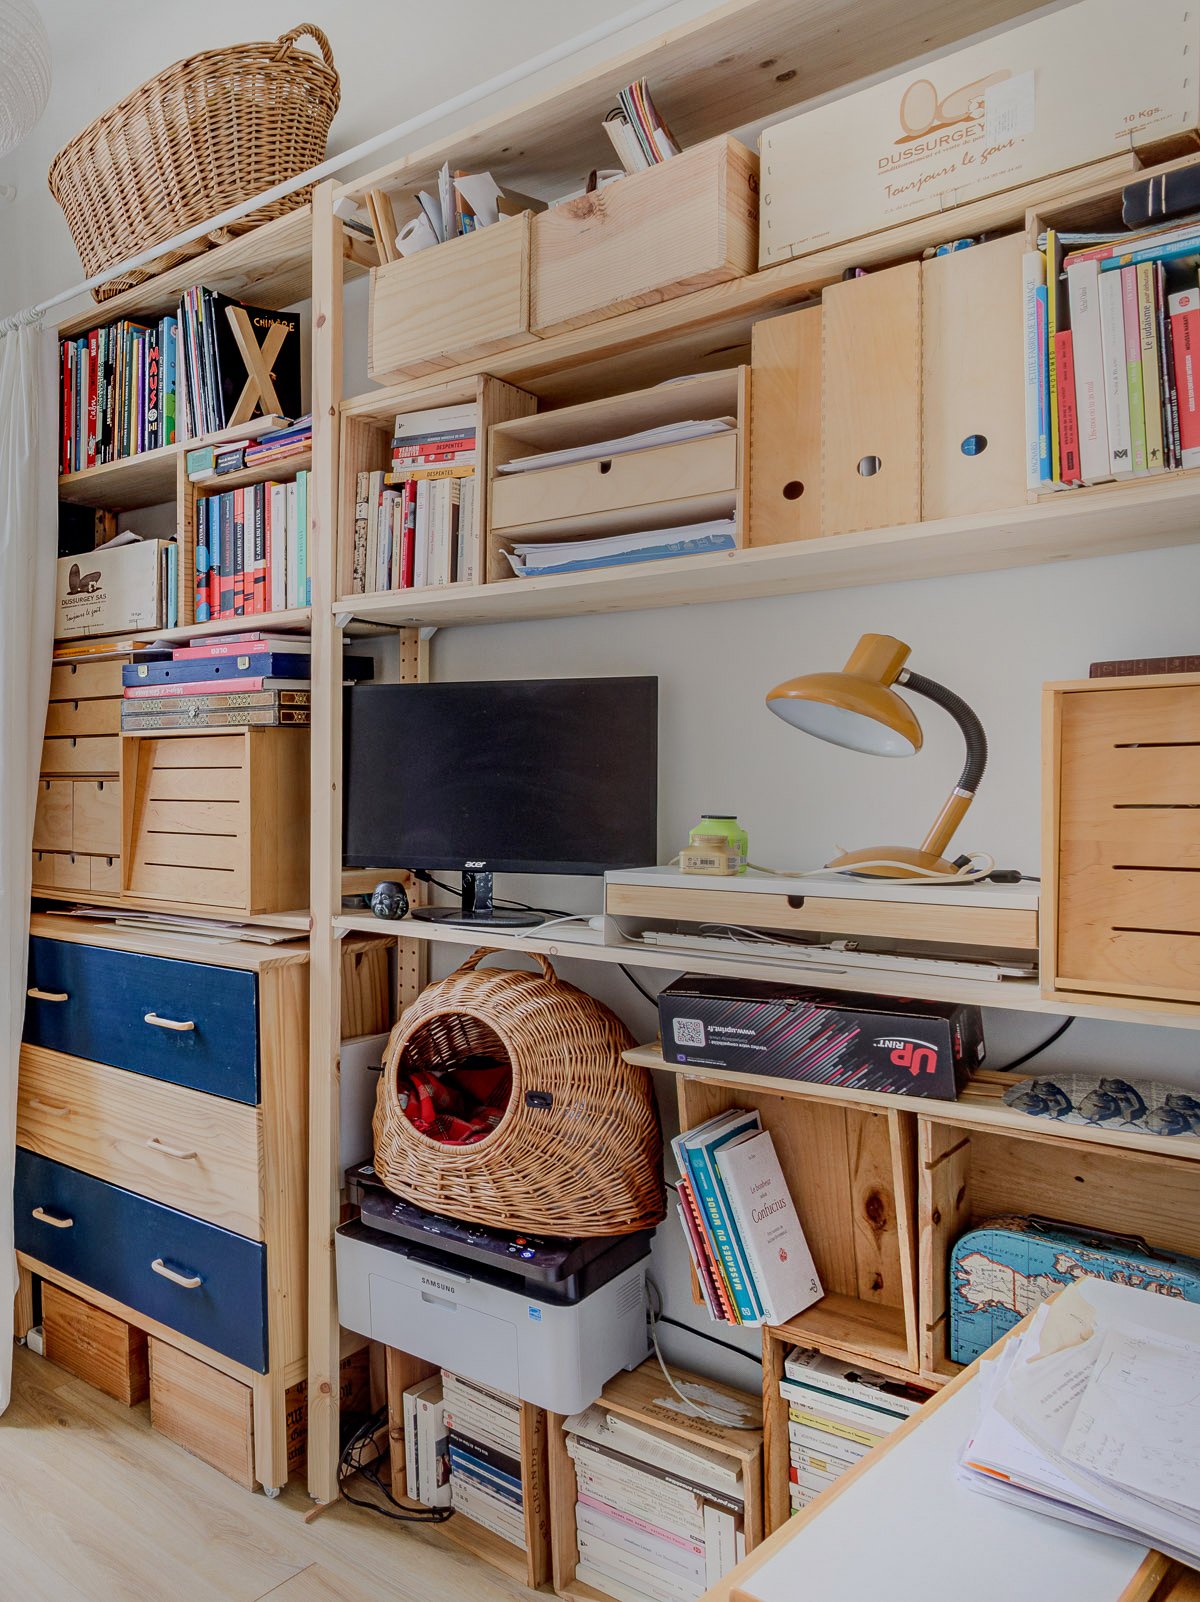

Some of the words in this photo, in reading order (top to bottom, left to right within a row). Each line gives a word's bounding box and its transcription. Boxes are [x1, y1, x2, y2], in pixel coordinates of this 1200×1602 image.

[1122, 113, 1137, 124] 10
[878, 122, 986, 170] DUSSURGEY
[148, 346, 159, 408] MAUS
[436, 442, 464, 450] DESPENTES
[61, 594, 94, 606] DUSSURGEY
[707, 1024, 756, 1036] www.uprint.fr
[706, 1196, 722, 1226] MONDE
[751, 1198, 787, 1224] Confucius
[716, 1230, 726, 1241] DU
[721, 1244, 742, 1290] MASSAGES
[421, 1276, 455, 1294] SAMSUNG
